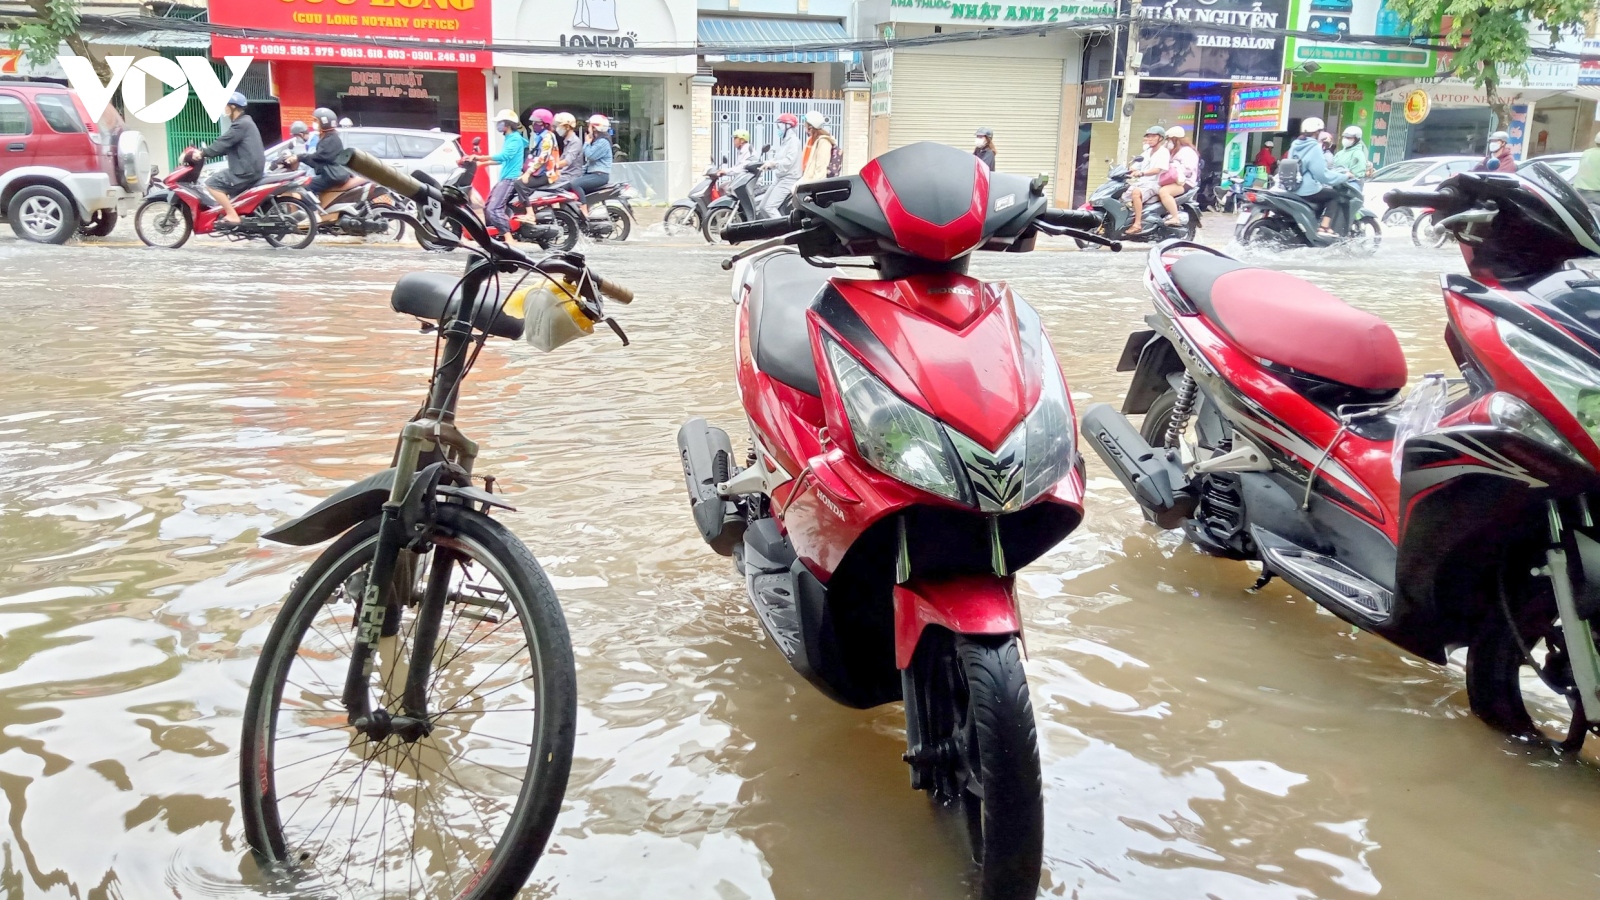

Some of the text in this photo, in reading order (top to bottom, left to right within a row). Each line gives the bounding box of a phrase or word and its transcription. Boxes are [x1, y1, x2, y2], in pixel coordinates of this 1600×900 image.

[951, 3, 1059, 22] NHẬT ANH 2
[1194, 2, 1279, 28] NGUYỄN
[293, 11, 459, 30] (CUU LONG NOTARY OFFICE)
[1197, 35, 1275, 49] HAIR SALON
[261, 45, 334, 56] 0909.583.979
[341, 48, 405, 60] 0913.618.603
[412, 51, 476, 62] 0901.246.919
[352, 68, 423, 88] DỊCH THUẬT
[347, 86, 369, 97] ANH
[376, 86, 402, 98] PHÁP
[409, 89, 428, 98] HOA
[1302, 81, 1326, 92] TÂM
[1085, 95, 1098, 106] HAIR
[1087, 107, 1103, 118] SALON
[927, 287, 974, 296] HONDA
[817, 488, 845, 522] HONDA
